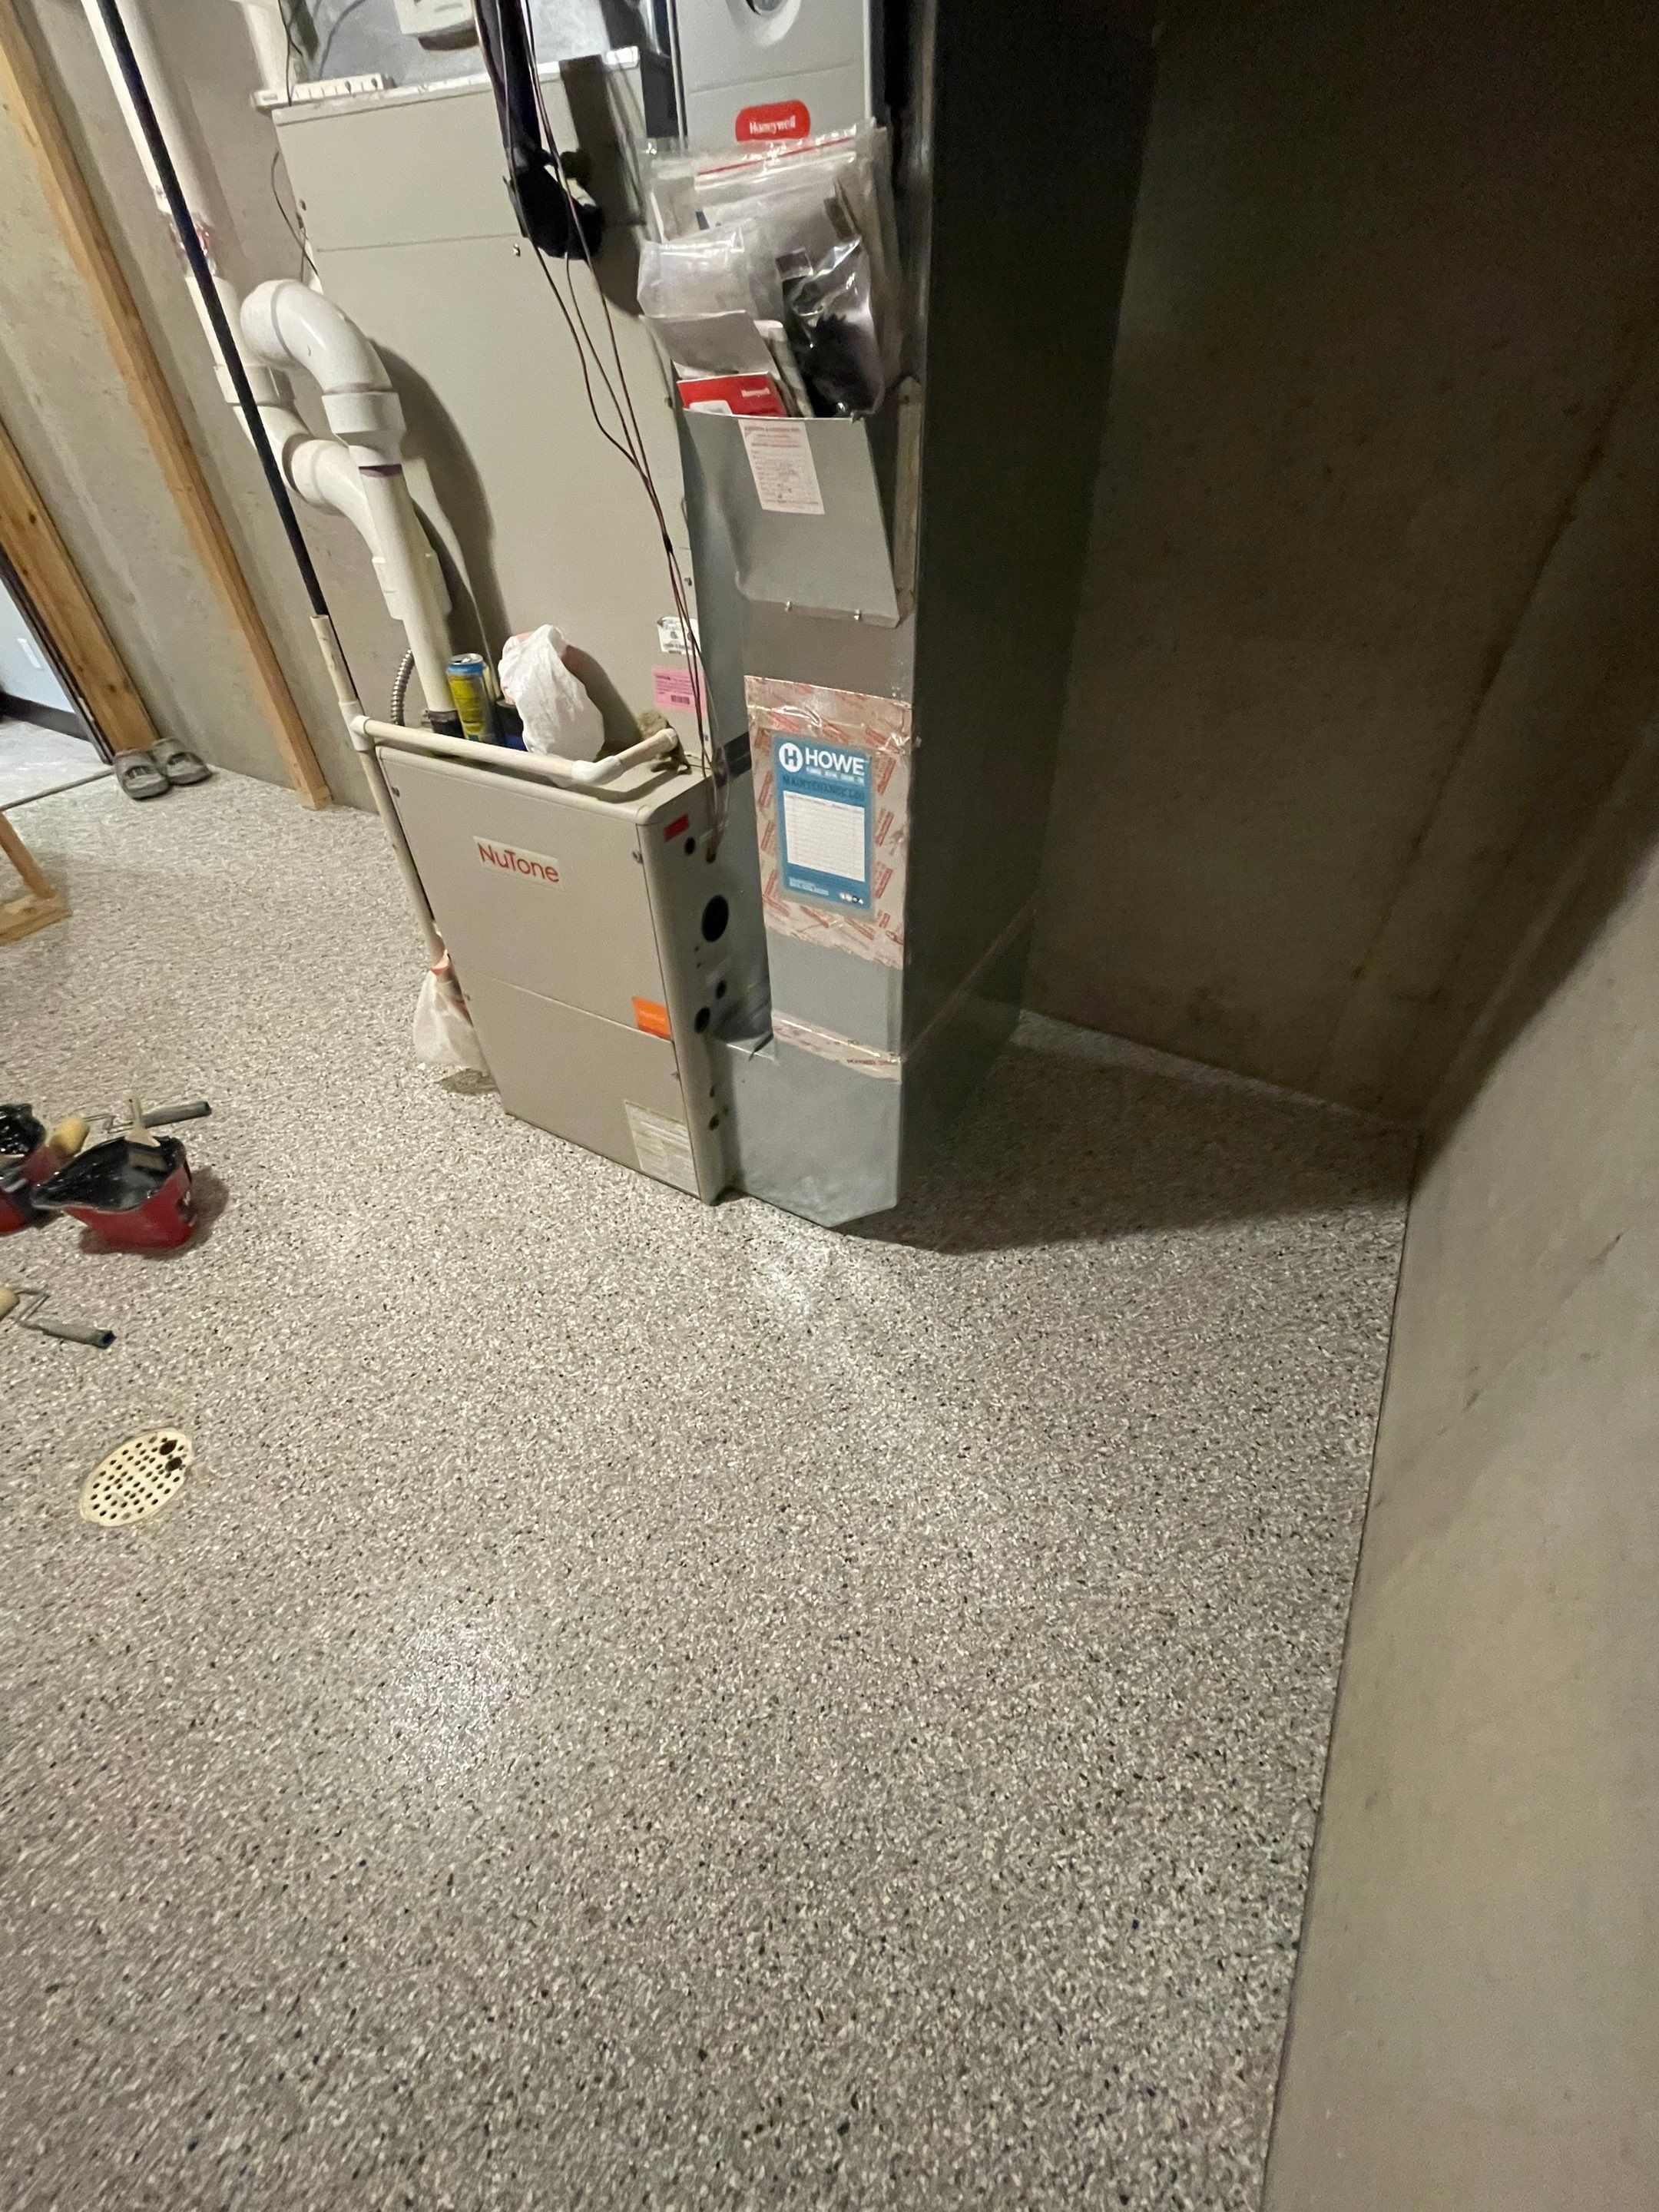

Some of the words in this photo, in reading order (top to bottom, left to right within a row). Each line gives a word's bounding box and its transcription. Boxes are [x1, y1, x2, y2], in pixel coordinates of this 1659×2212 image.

[749, 115, 796, 134] Honeywell
[805, 747, 865, 777] HOWE
[477, 843, 559, 882] NuTone
